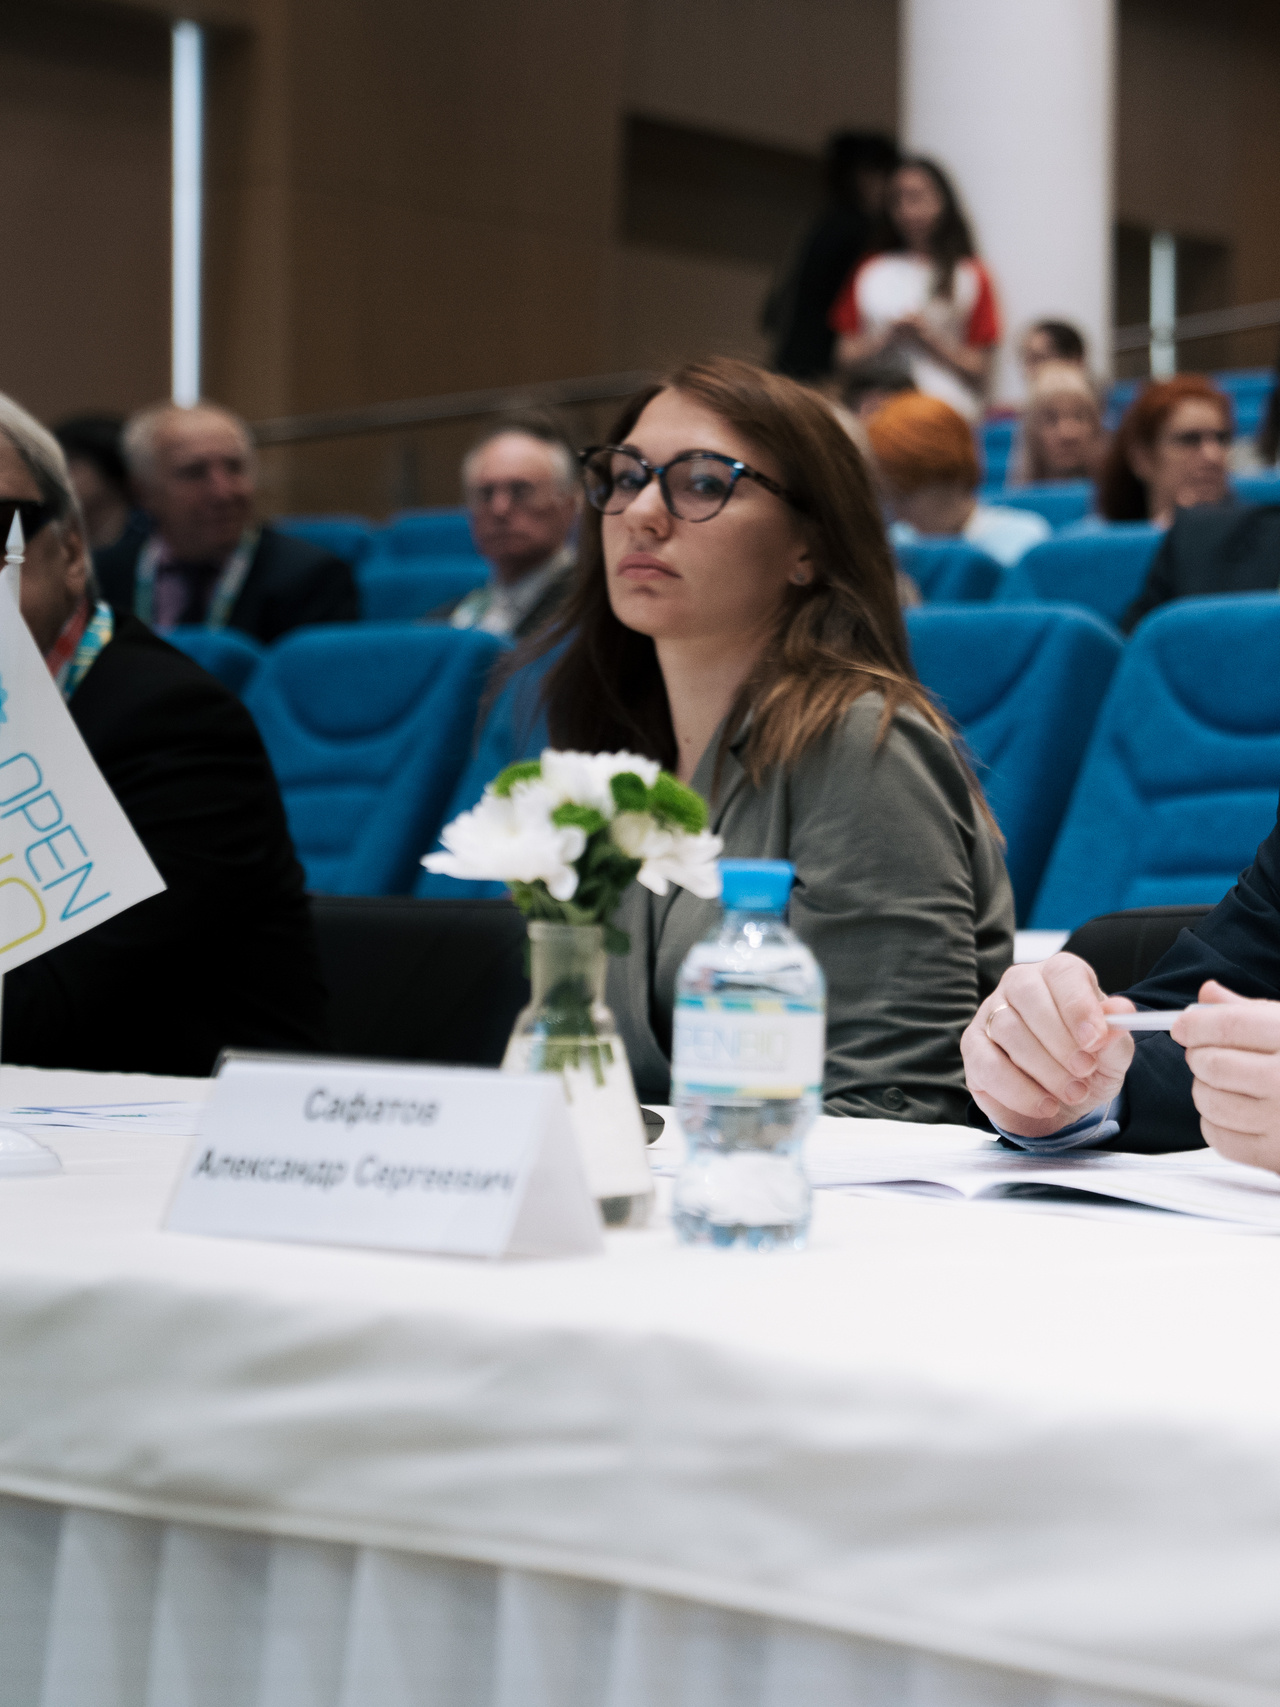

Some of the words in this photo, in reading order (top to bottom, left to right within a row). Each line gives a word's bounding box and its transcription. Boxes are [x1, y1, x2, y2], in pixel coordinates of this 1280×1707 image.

[0, 752, 111, 922] OPEN
[302, 1086, 441, 1130] Сафатов
[193, 1147, 349, 1192] Александр
[354, 1153, 516, 1198] Сергеевич
